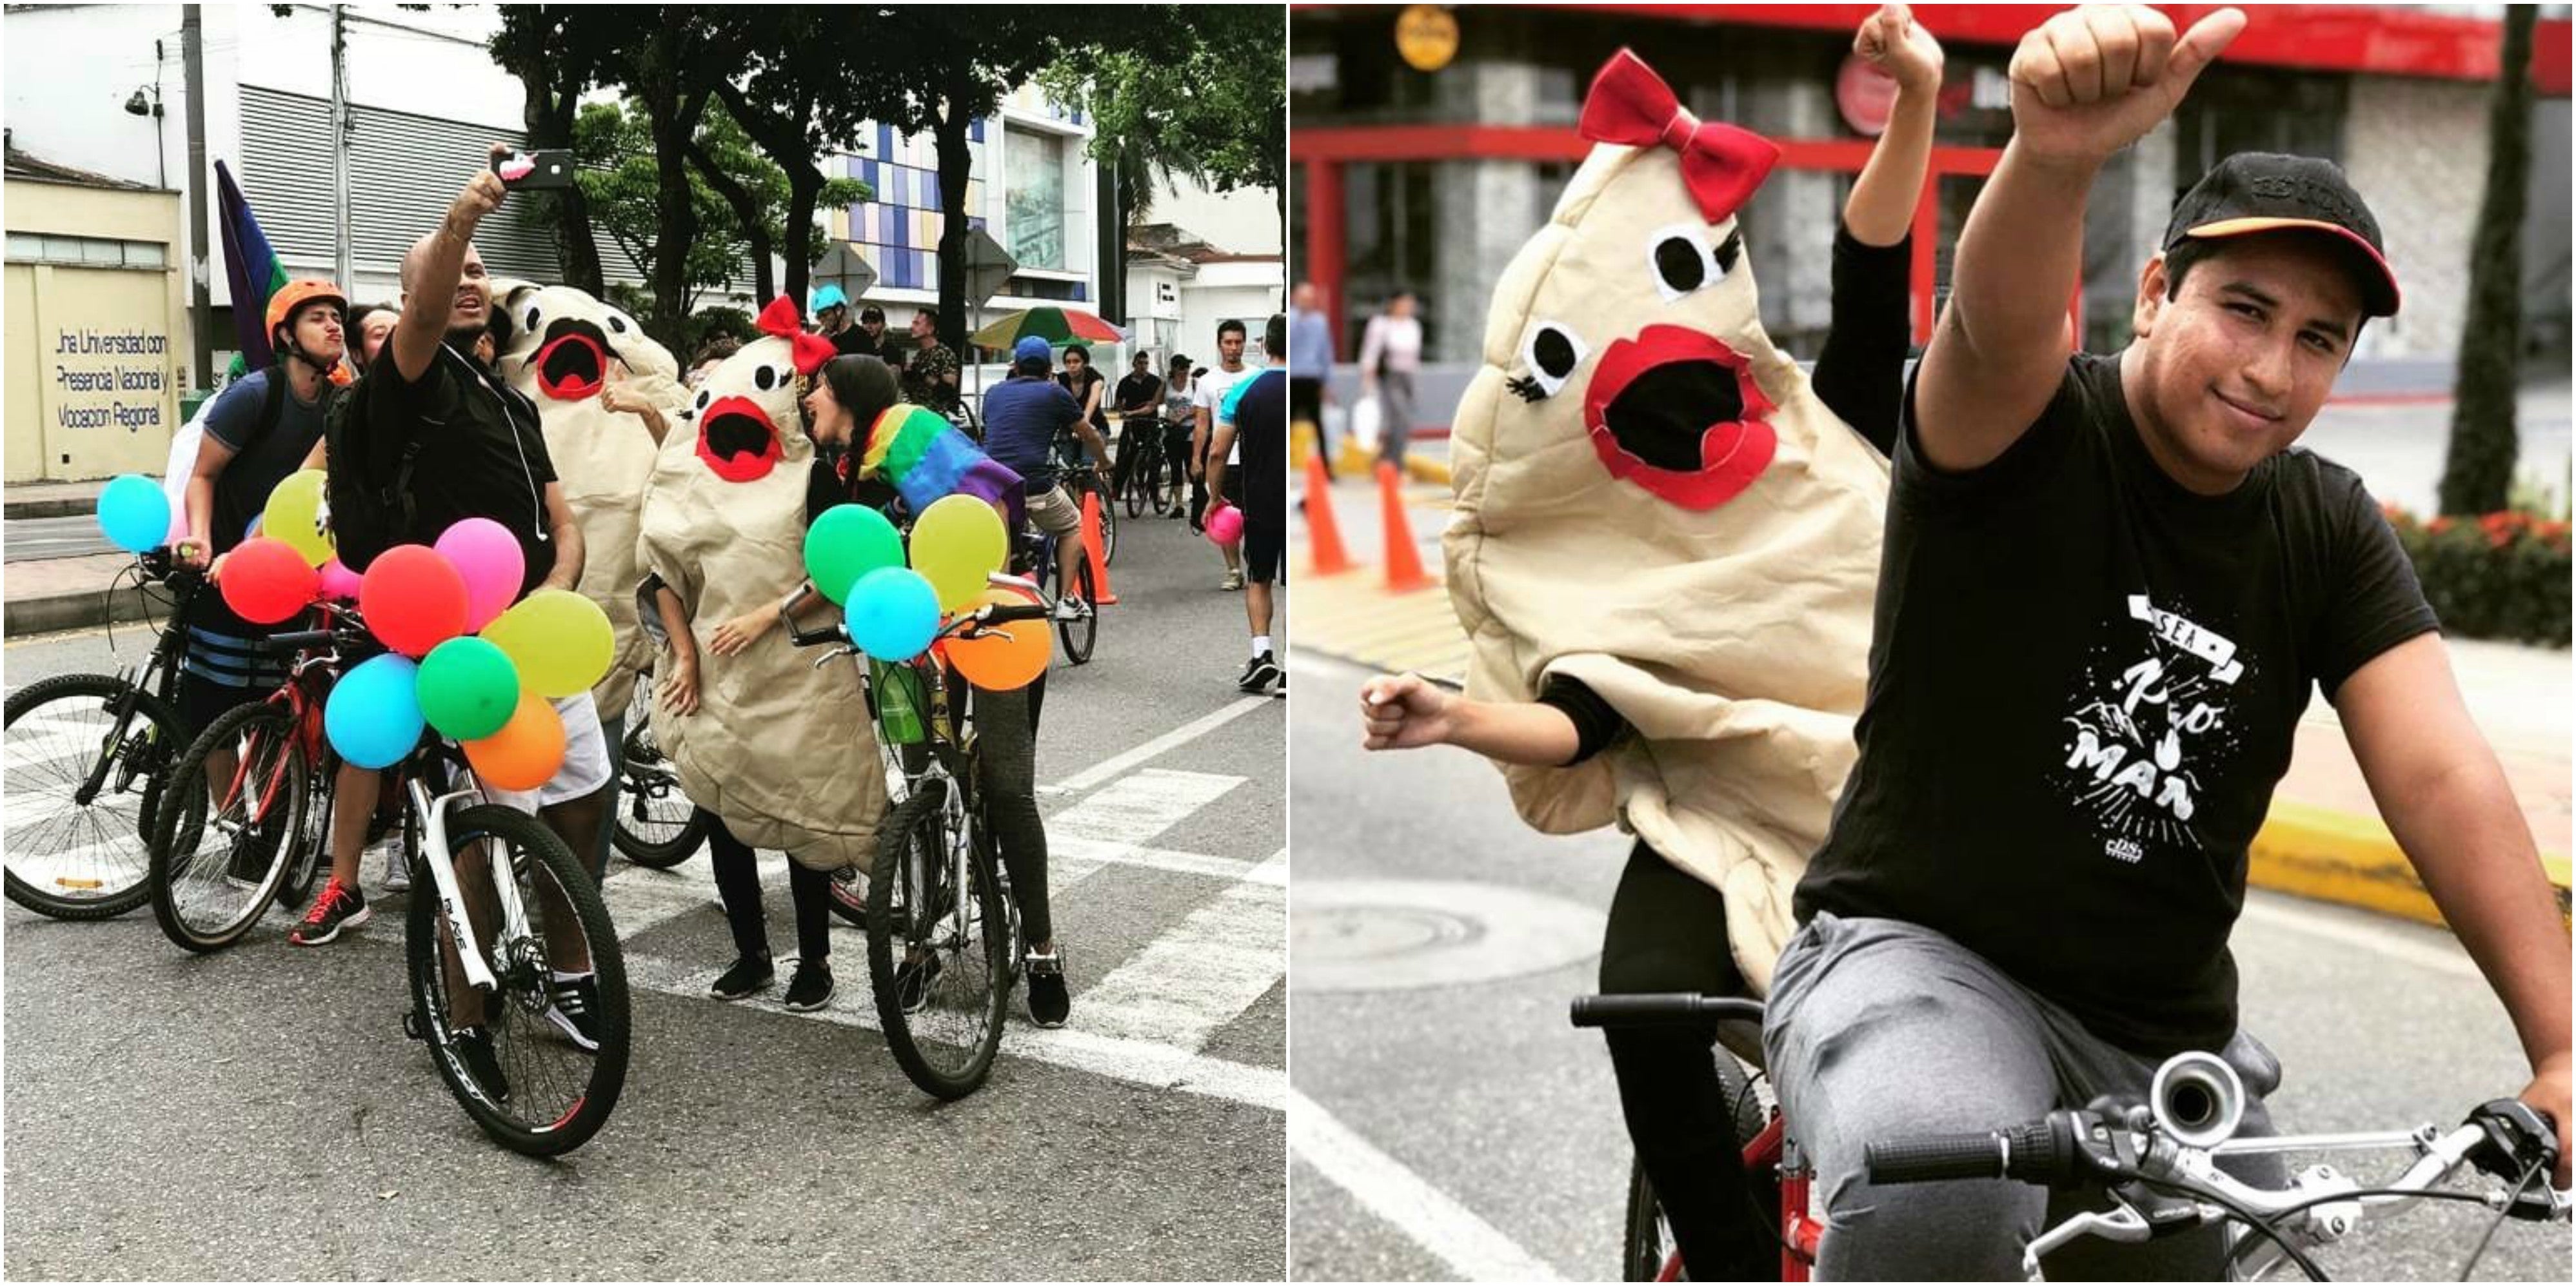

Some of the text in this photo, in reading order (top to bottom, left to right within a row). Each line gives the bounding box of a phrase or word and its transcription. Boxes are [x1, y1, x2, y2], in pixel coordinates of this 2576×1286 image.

[79, 328, 144, 353] Universidad
[147, 335, 167, 353] con
[57, 365, 168, 395] Presencia Nacional y
[114, 401, 160, 433] Regional
[2158, 614, 2197, 649] SEA
